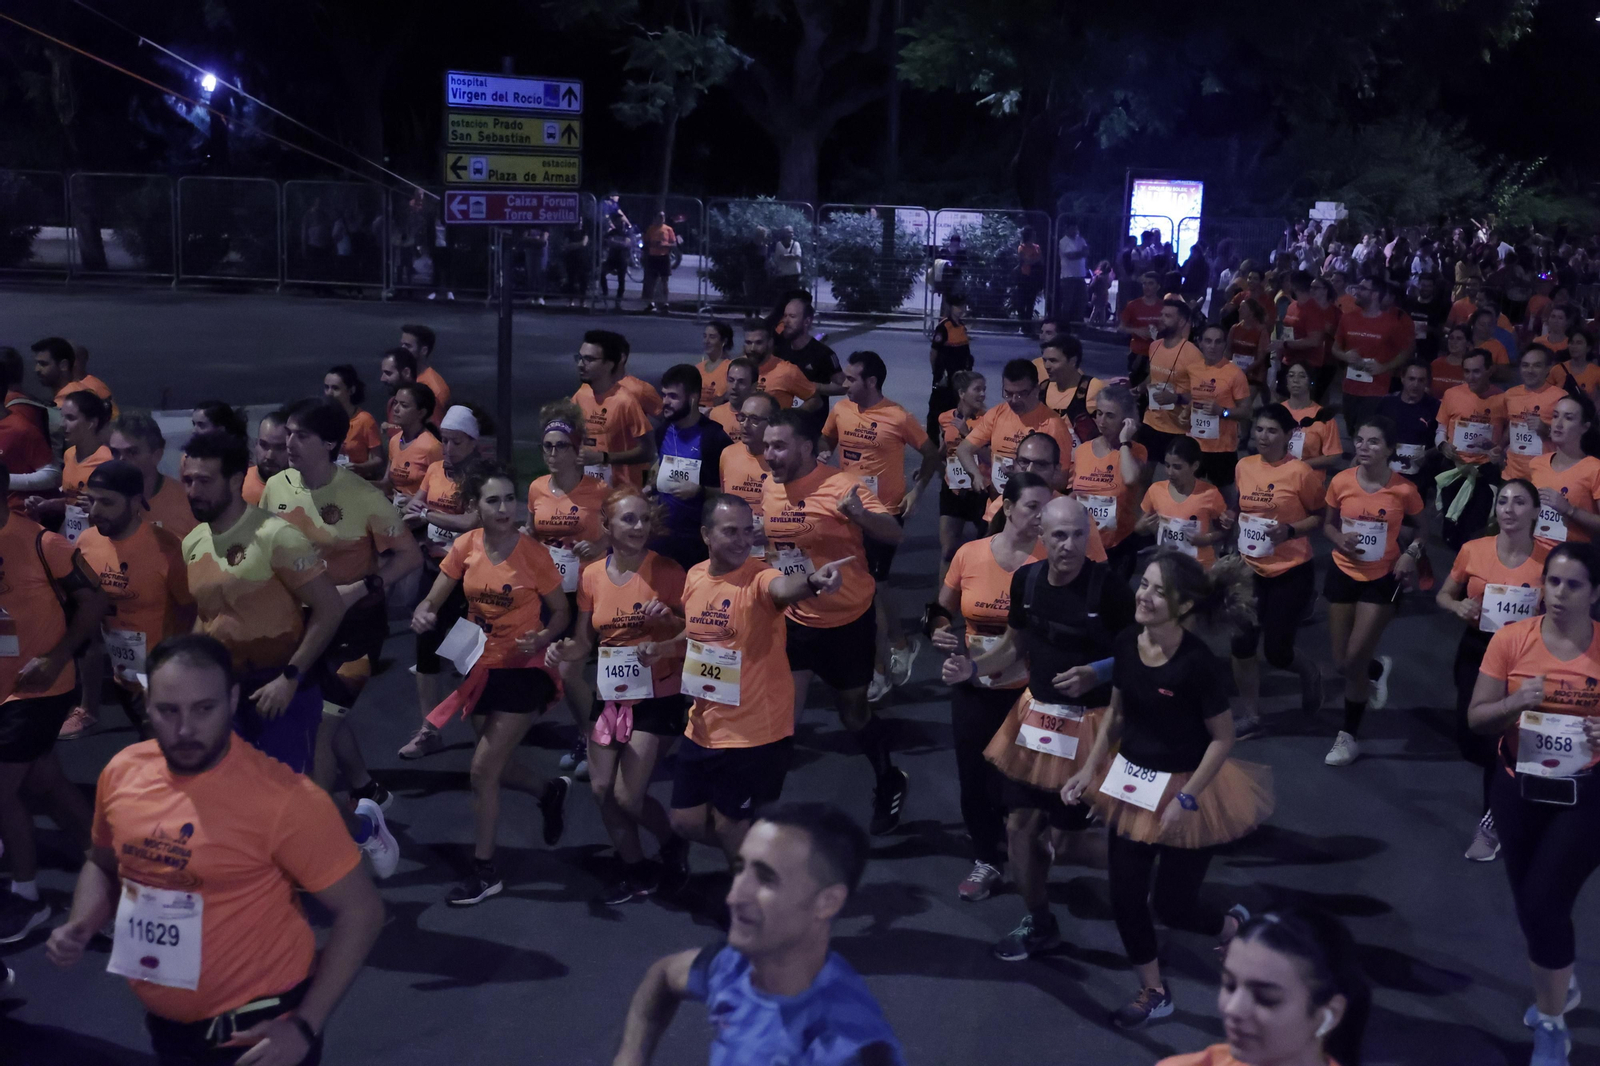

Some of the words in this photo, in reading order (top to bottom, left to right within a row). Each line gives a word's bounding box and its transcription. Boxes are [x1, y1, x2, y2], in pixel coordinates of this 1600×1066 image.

[451, 76, 487, 87] hospital
[451, 88, 486, 102] Virgen
[492, 91, 508, 102] del
[494, 118, 523, 130] Prado
[451, 130, 472, 141] San
[489, 170, 517, 181] Plaza
[524, 171, 536, 181] de
[543, 172, 576, 182] Armas
[507, 195, 538, 206] Caixa
[543, 195, 576, 207] Forum
[504, 208, 533, 220] Torre
[539, 209, 575, 220] Sevilla
[1196, 419, 1211, 427] 5219
[1516, 433, 1532, 442] 5162
[1244, 528, 1266, 542] 16204
[468, 596, 496, 605] SEVILLA
[480, 592, 514, 601] NOCTURNA
[975, 601, 1010, 610] SEVILLA
[1497, 601, 1530, 615] 14144
[690, 616, 714, 625] SEVILLA
[701, 611, 730, 619] NOCTURNA
[600, 622, 627, 630] SEVILLA
[605, 665, 640, 678] 14876
[700, 664, 721, 680] 242
[1040, 715, 1065, 732] 1392
[1536, 734, 1572, 752] 3658
[1124, 760, 1157, 782] 16289
[122, 844, 164, 863] SEVILLA
[144, 838, 192, 857] NOCTURNA
[129, 917, 180, 946] 11629
